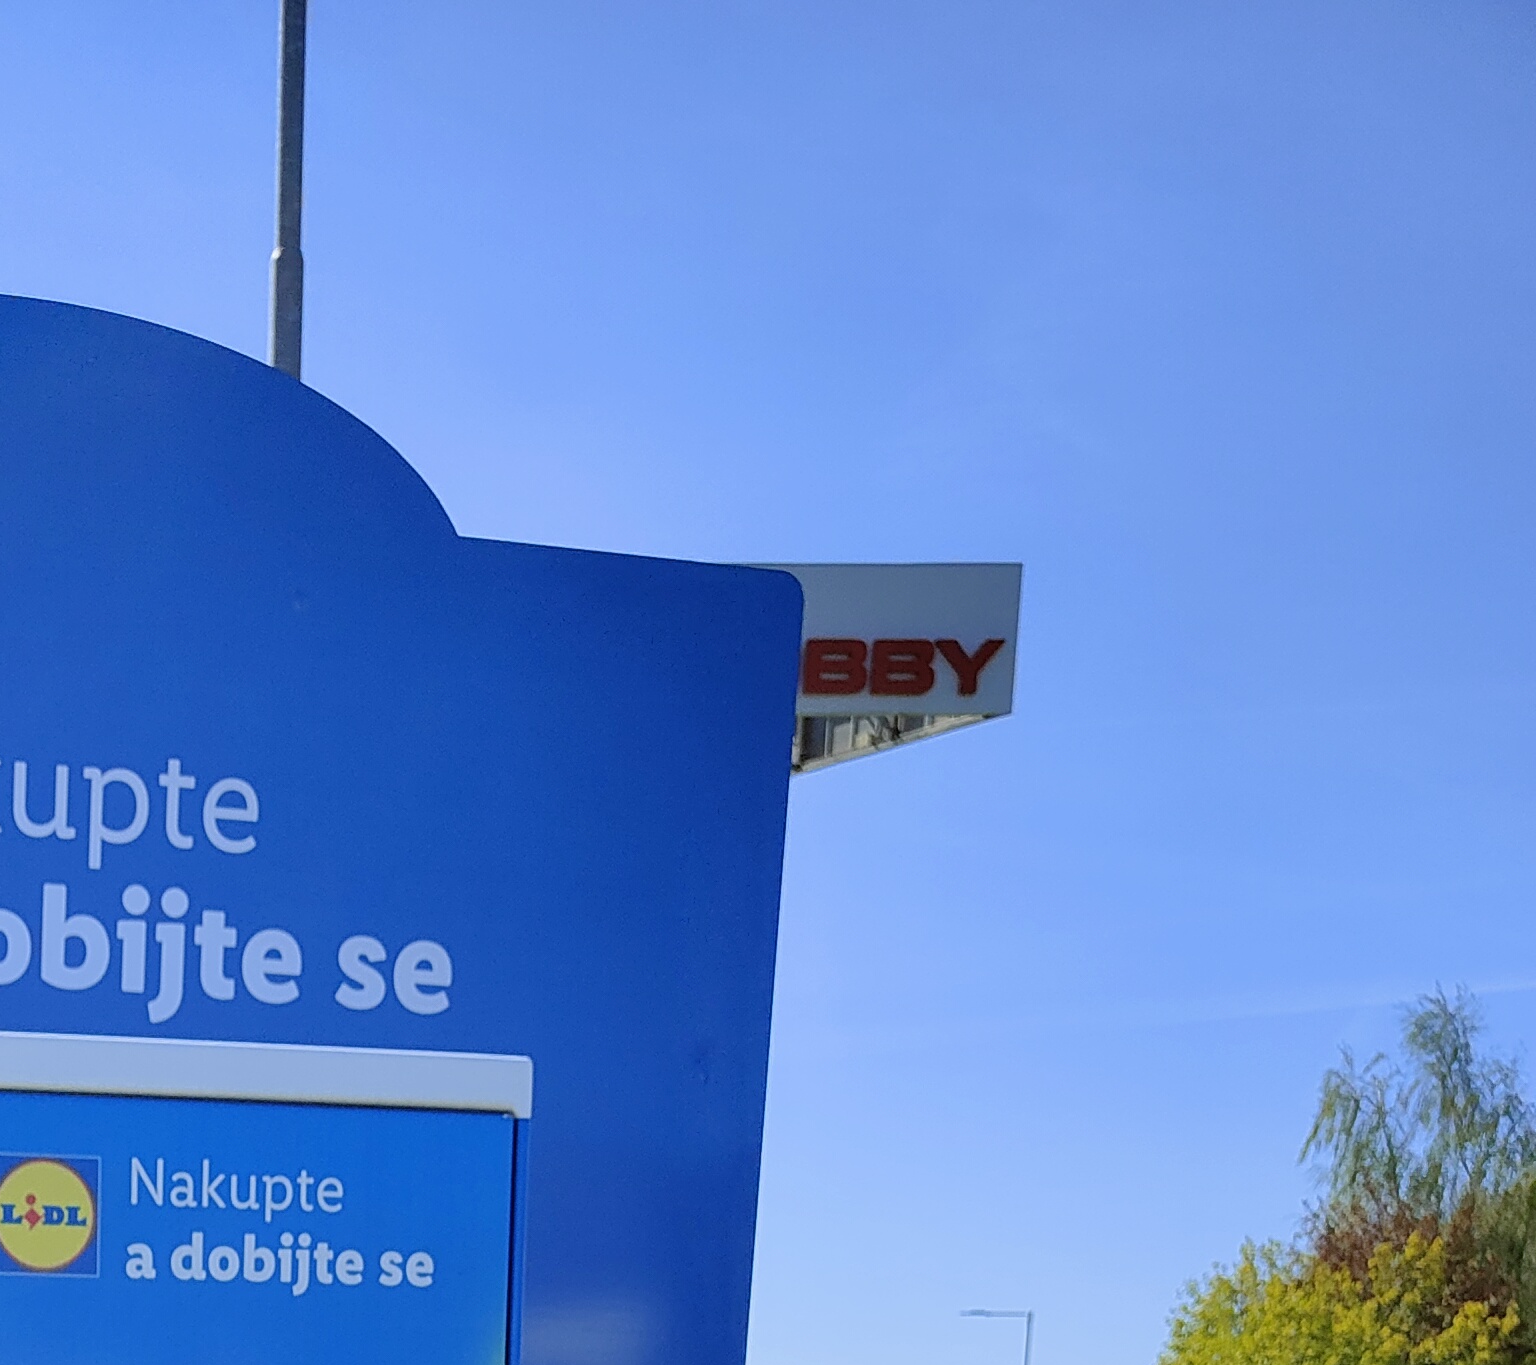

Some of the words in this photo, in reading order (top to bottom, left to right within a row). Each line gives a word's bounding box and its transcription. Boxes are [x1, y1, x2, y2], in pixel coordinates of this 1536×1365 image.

[334, 934, 454, 1016] se
[129, 1156, 345, 1223] Nakupte
[124, 1241, 156, 1280] a
[170, 1231, 364, 1297] dobijte
[378, 1248, 435, 1288] se
